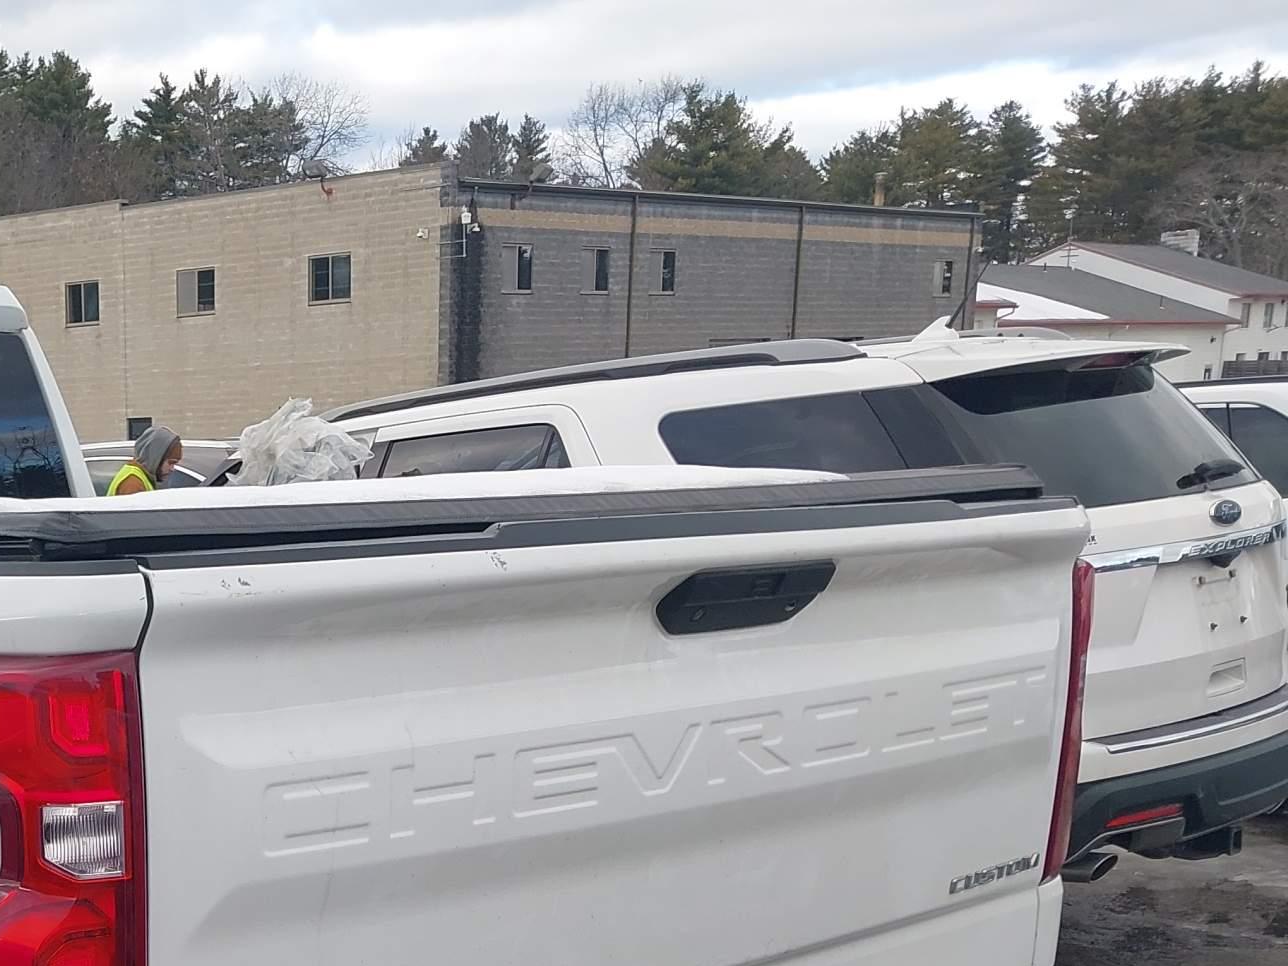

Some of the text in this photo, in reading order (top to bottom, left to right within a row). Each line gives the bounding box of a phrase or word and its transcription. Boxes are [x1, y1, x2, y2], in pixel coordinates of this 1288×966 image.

[1188, 531, 1271, 557] EXPLORER
[261, 665, 1048, 858] CHEVROLET
[948, 852, 1041, 895] CUSTOM
